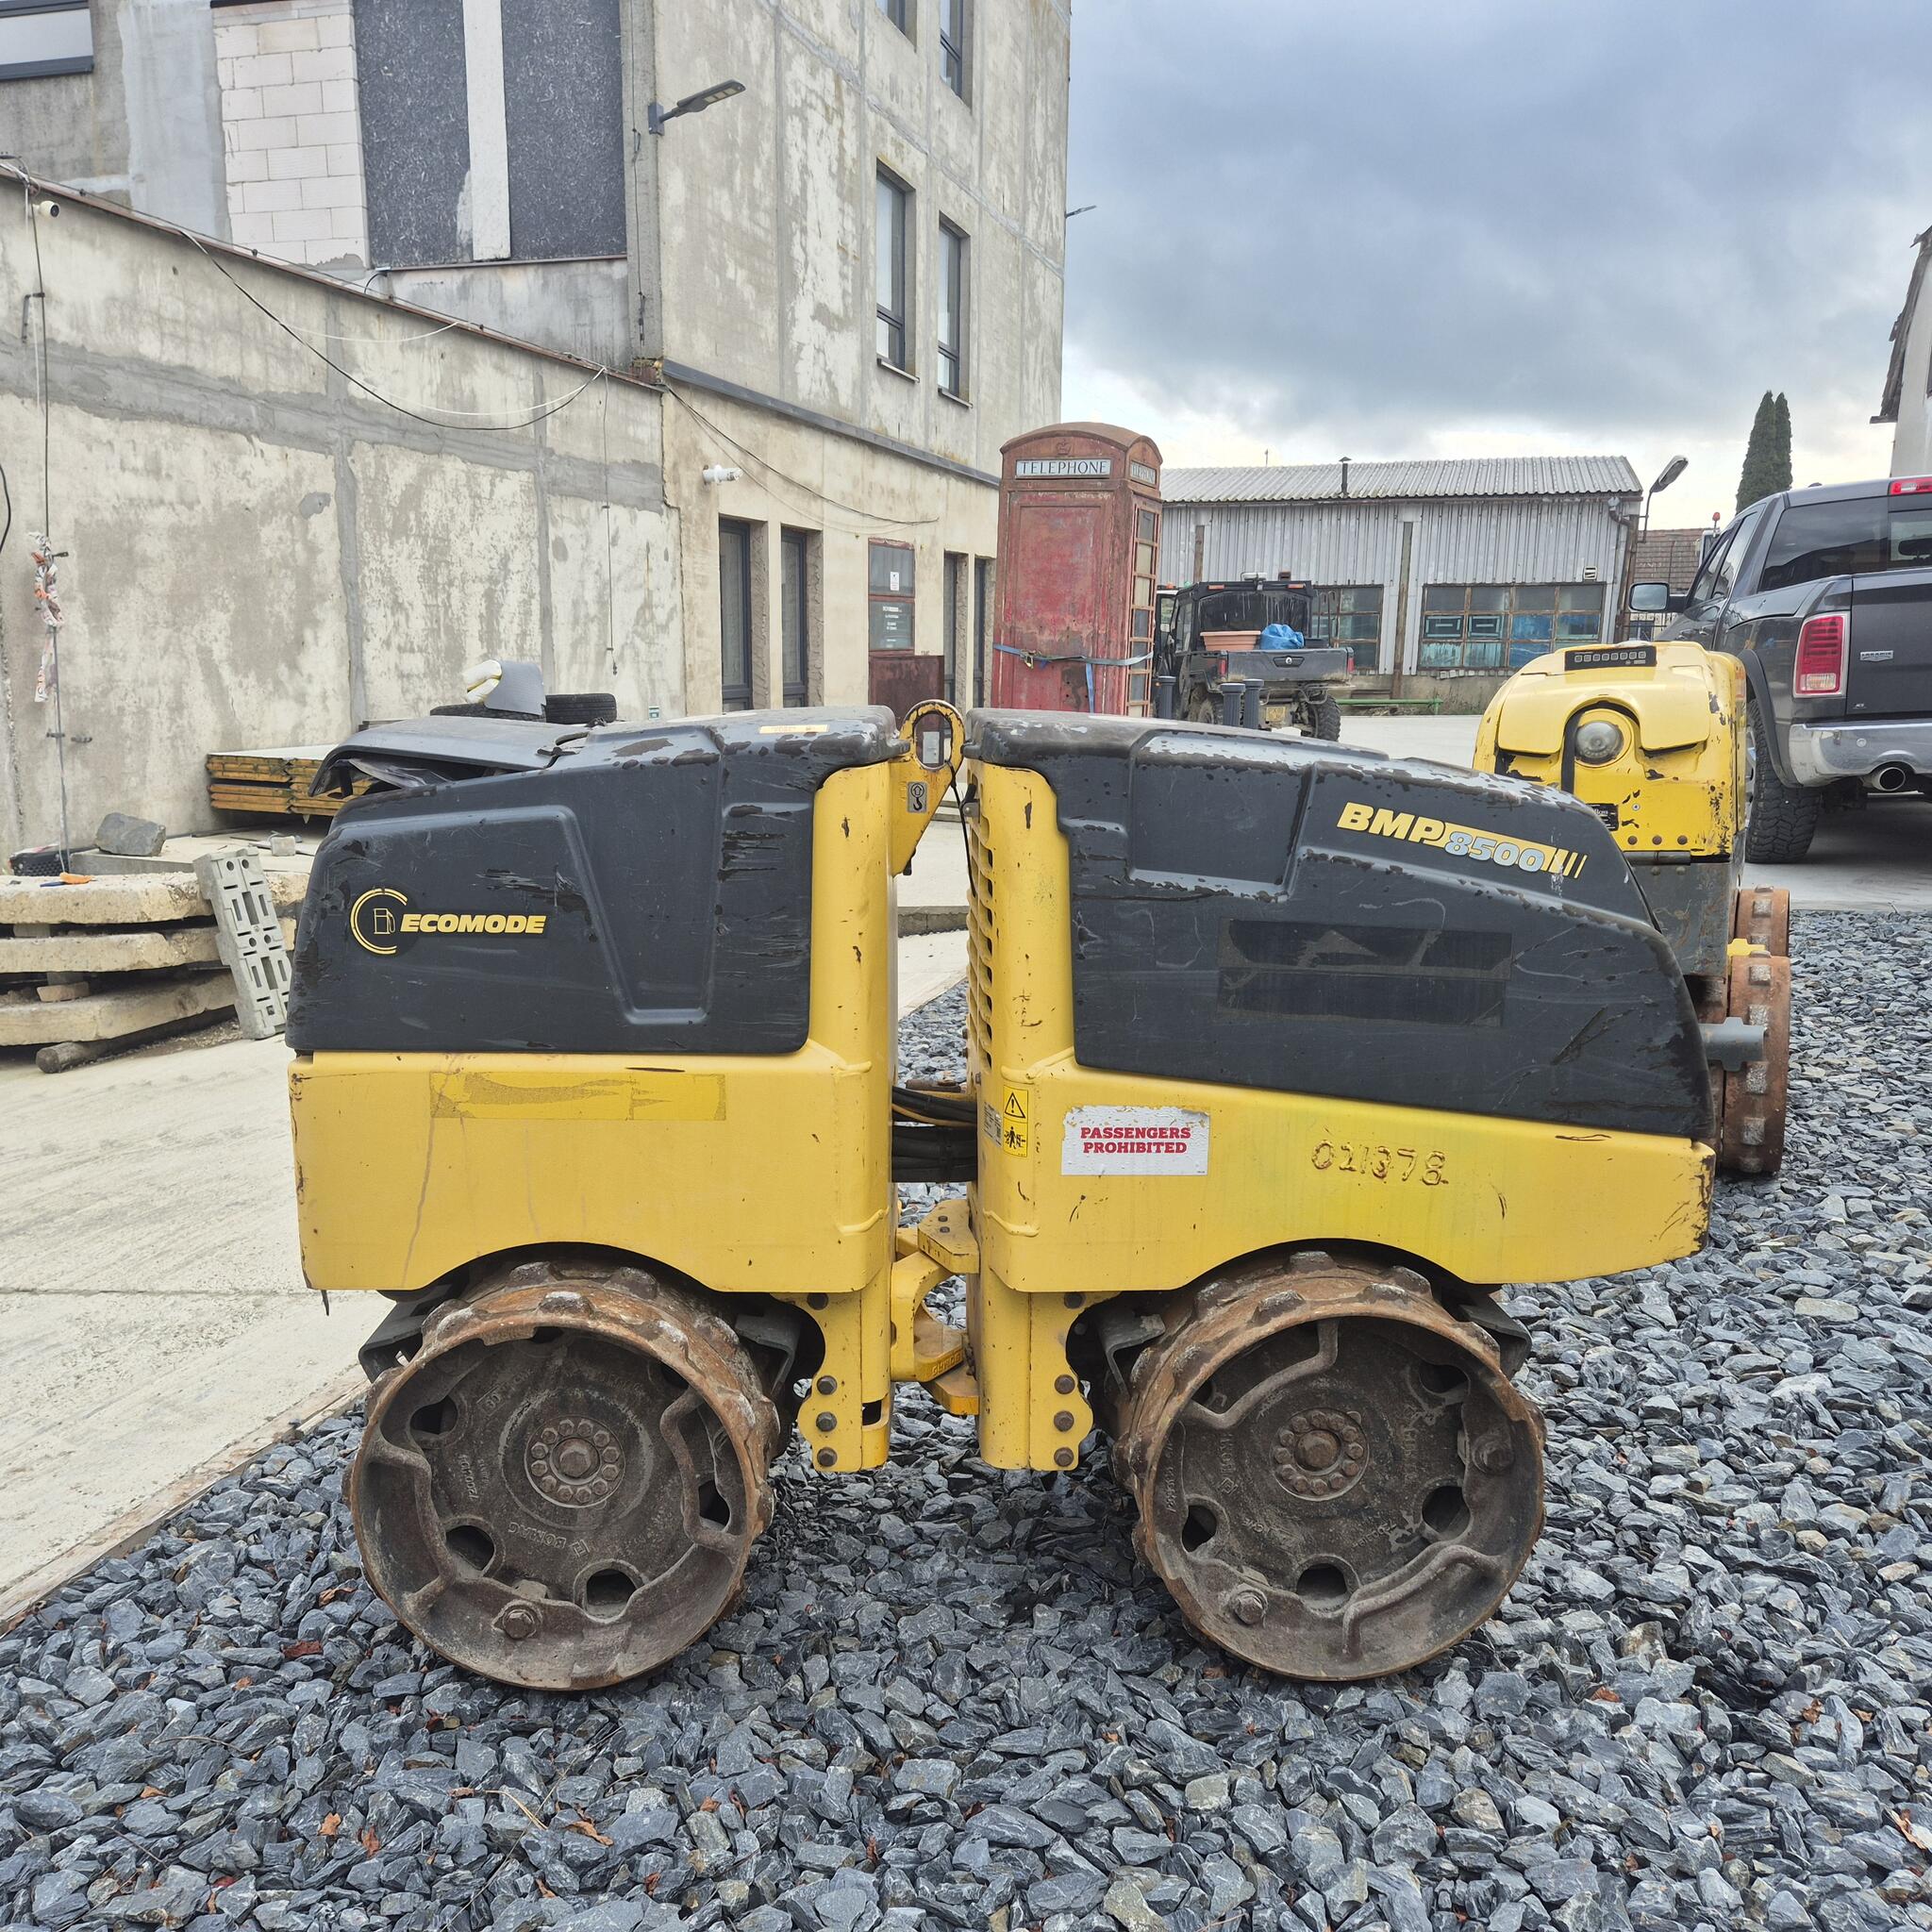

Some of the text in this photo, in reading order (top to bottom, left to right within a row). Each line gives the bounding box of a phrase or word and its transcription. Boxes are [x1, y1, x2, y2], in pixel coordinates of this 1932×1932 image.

[1021, 460, 1108, 475] TELEPHONE
[400, 913, 547, 934] ECOMODE
[1080, 1126, 1191, 1140] PASSENGERS
[1083, 1141, 1188, 1154] PROHIBITED
